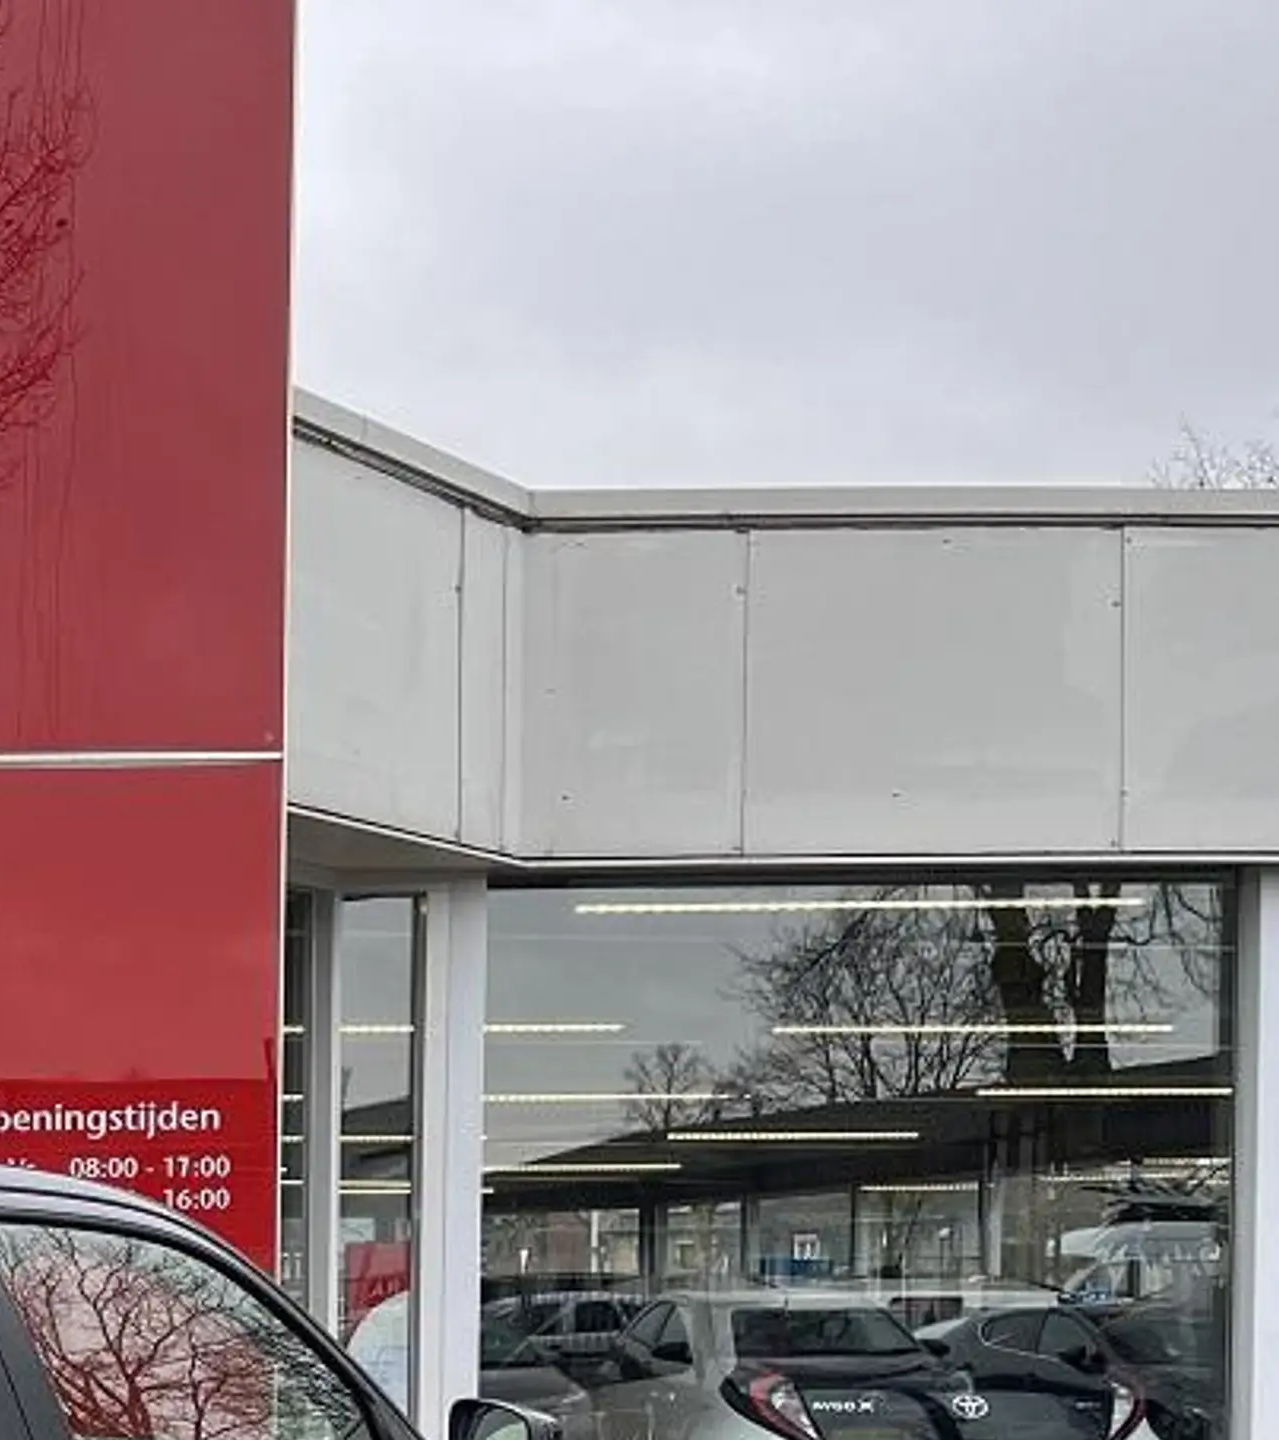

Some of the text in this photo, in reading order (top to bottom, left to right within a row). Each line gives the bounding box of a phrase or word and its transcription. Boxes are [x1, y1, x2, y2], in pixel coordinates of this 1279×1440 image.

[69, 1156, 139, 1178] 08:00
[163, 1155, 231, 1178] 17:00
[163, 1188, 231, 1210] 16:00
